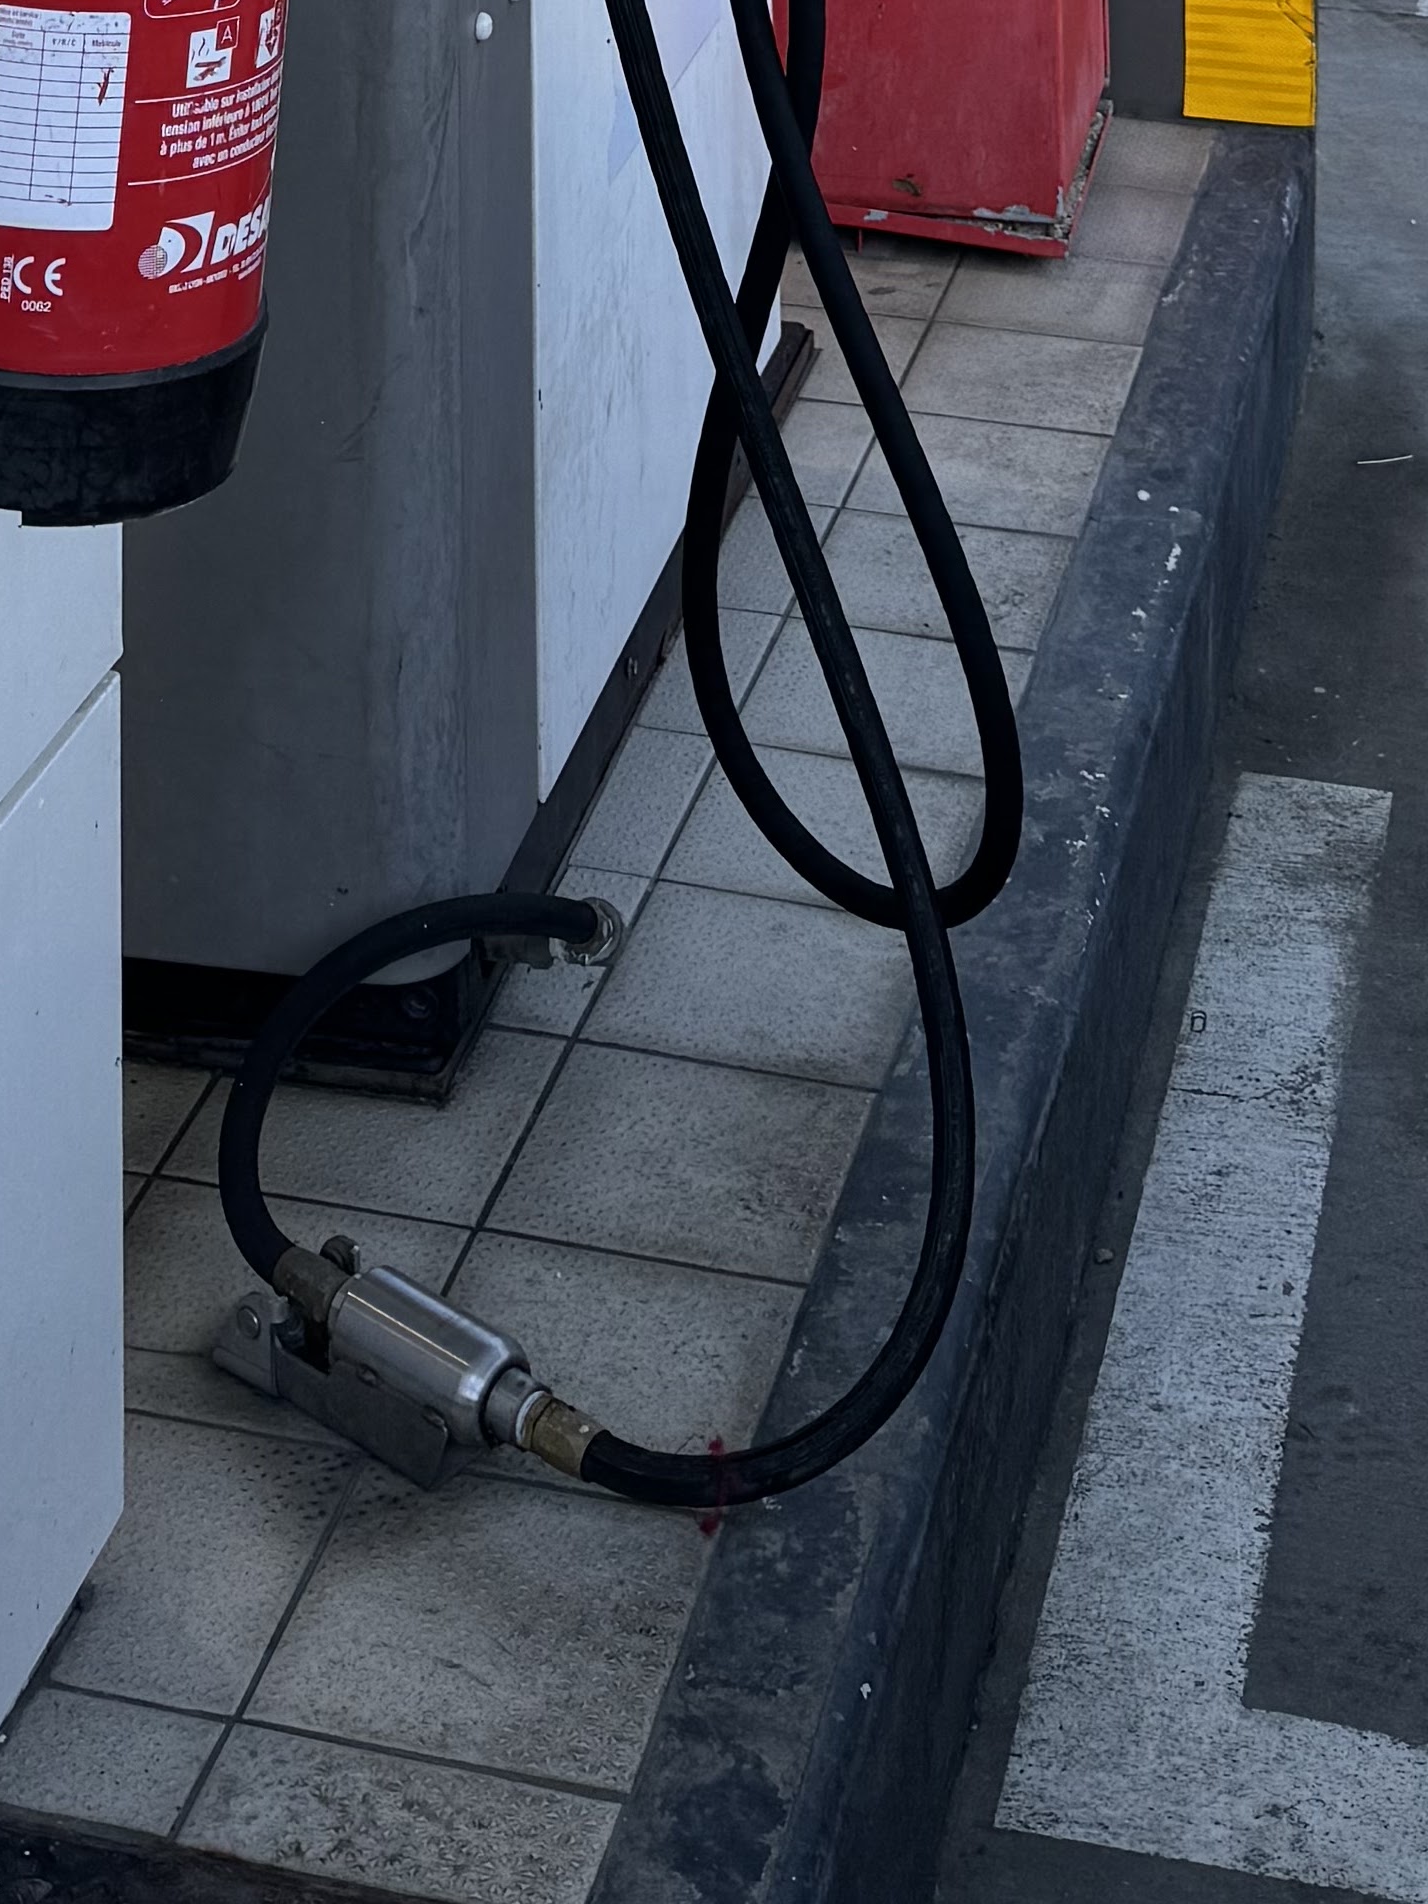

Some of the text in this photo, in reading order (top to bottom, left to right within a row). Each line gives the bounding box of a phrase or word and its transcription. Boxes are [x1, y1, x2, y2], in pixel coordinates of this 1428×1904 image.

[222, 25, 234, 43] A
[220, 94, 236, 108] sur
[161, 119, 201, 138] tension
[202, 108, 245, 131] inférieure
[160, 139, 168, 157] à
[169, 138, 193, 158] plus
[194, 134, 208, 151] de
[192, 153, 217, 169] avec
[217, 149, 229, 163] un
[20, 299, 52, 313] 0062
